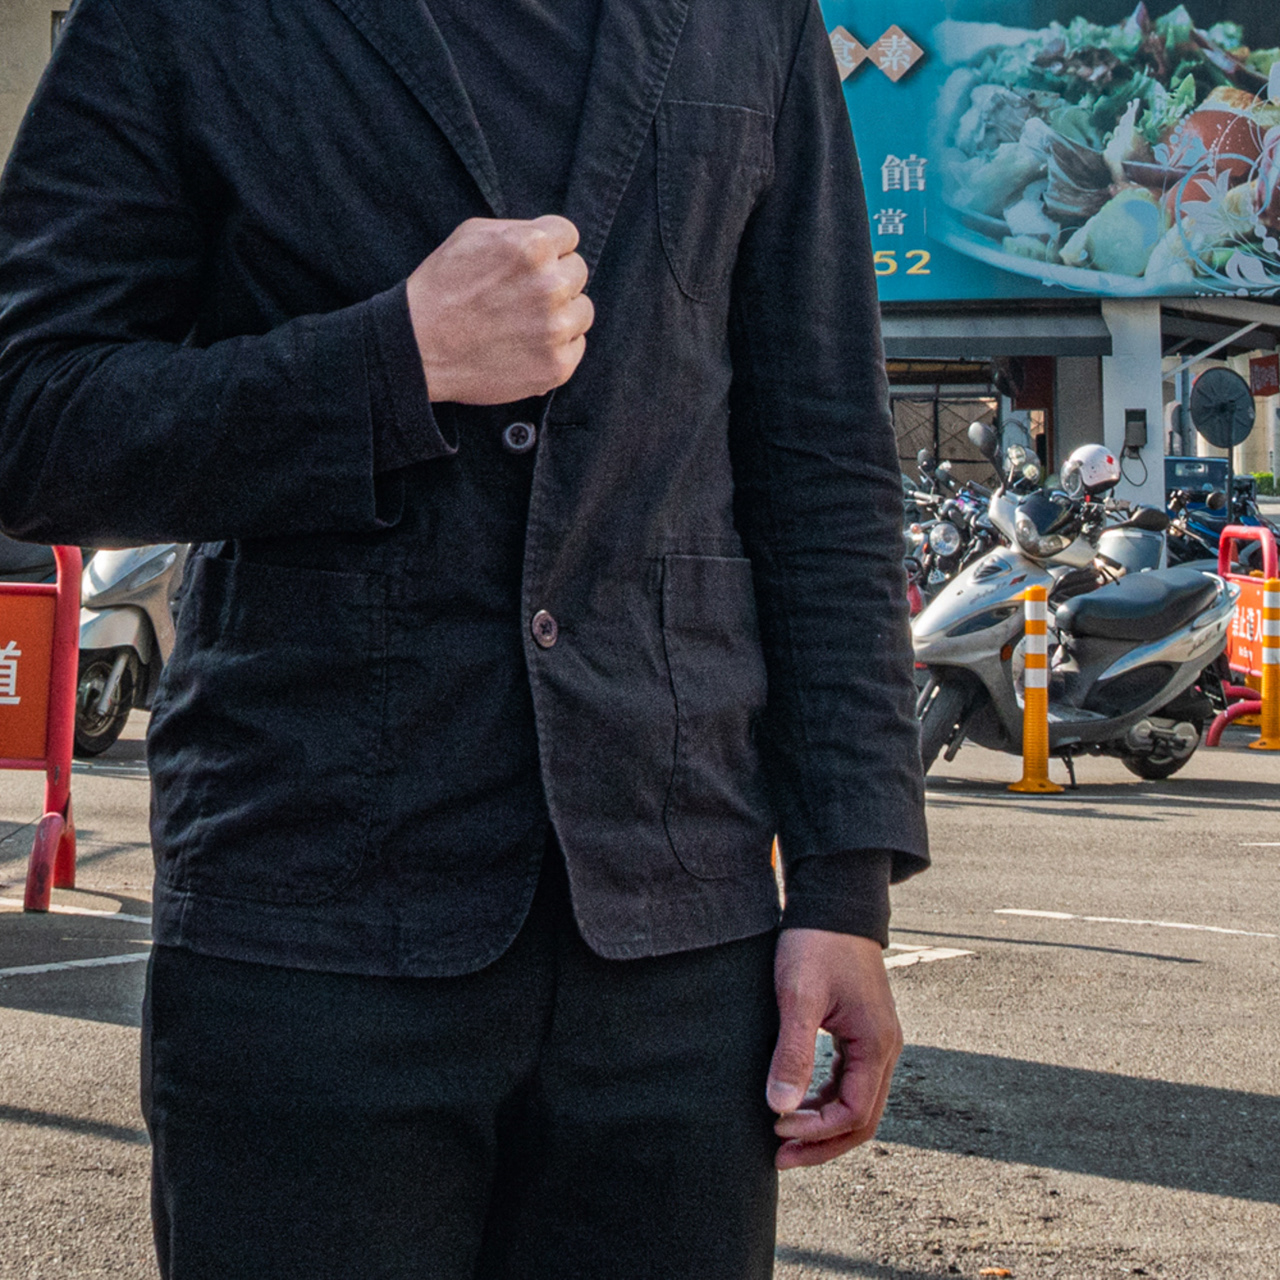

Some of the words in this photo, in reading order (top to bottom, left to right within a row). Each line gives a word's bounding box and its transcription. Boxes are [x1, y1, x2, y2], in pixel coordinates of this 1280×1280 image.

[880, 153, 929, 192] 館
[872, 208, 909, 236] 當
[873, 249, 932, 276] 52
